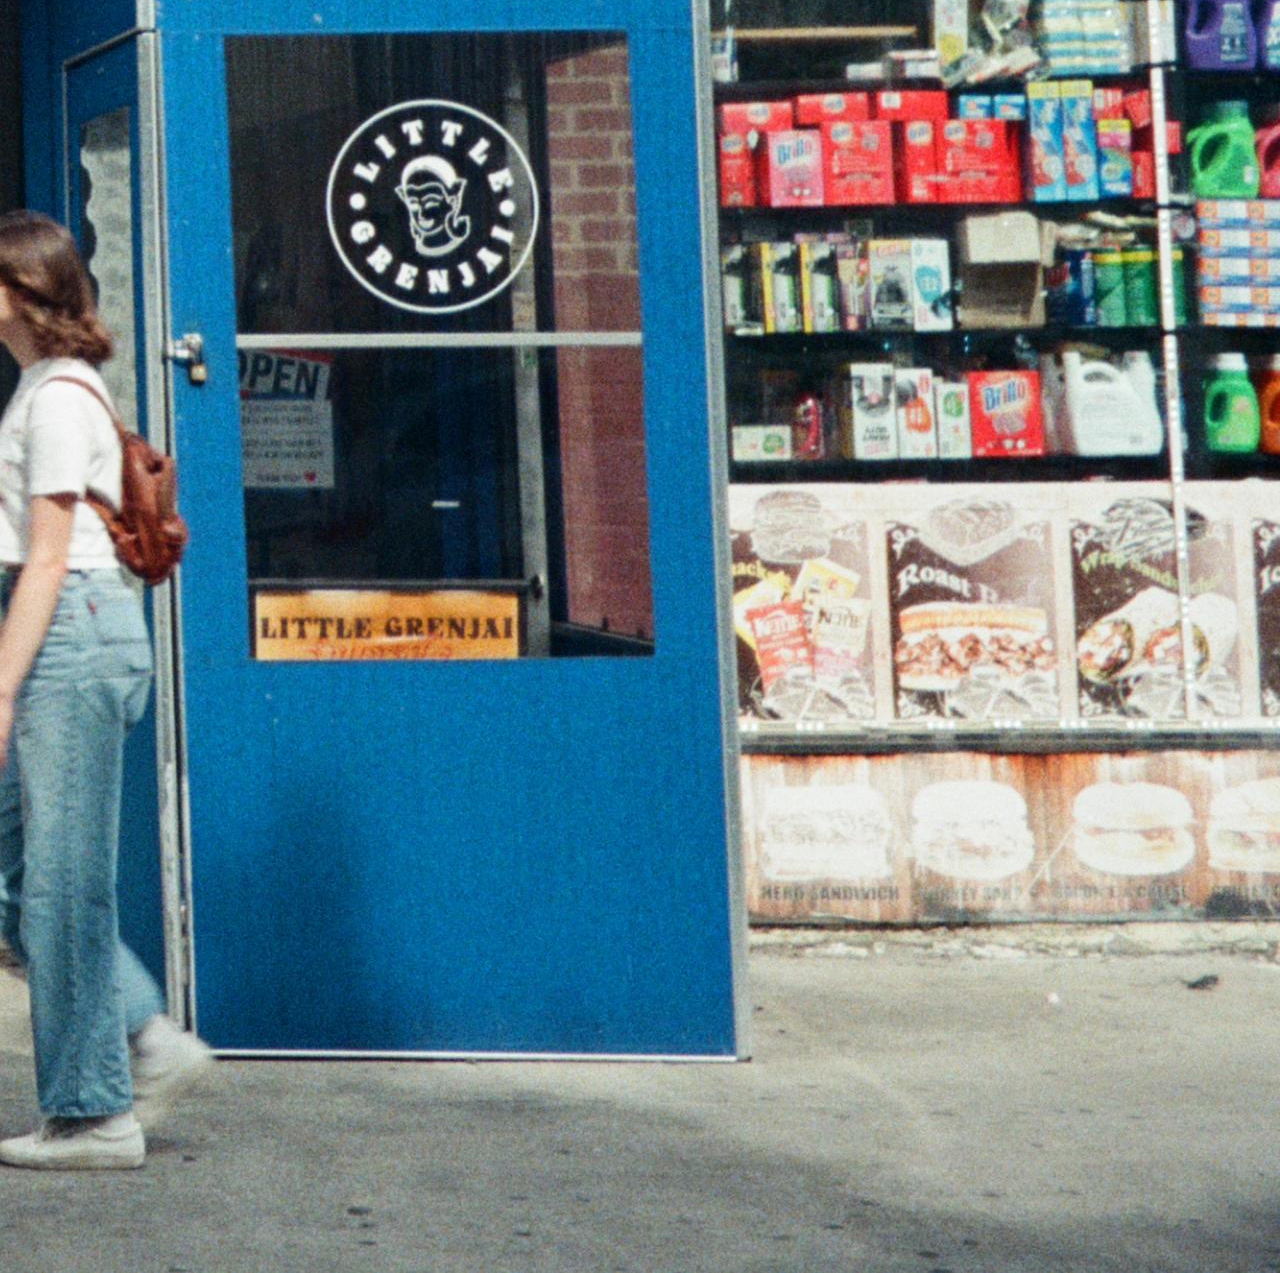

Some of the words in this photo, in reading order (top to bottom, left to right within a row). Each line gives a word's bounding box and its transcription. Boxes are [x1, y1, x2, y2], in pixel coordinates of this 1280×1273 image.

[353, 119, 514, 193] LITTLE
[350, 220, 514, 294] GRENJAI
[260, 616, 372, 640] LITTLE
[384, 616, 514, 640] GRENJAI
